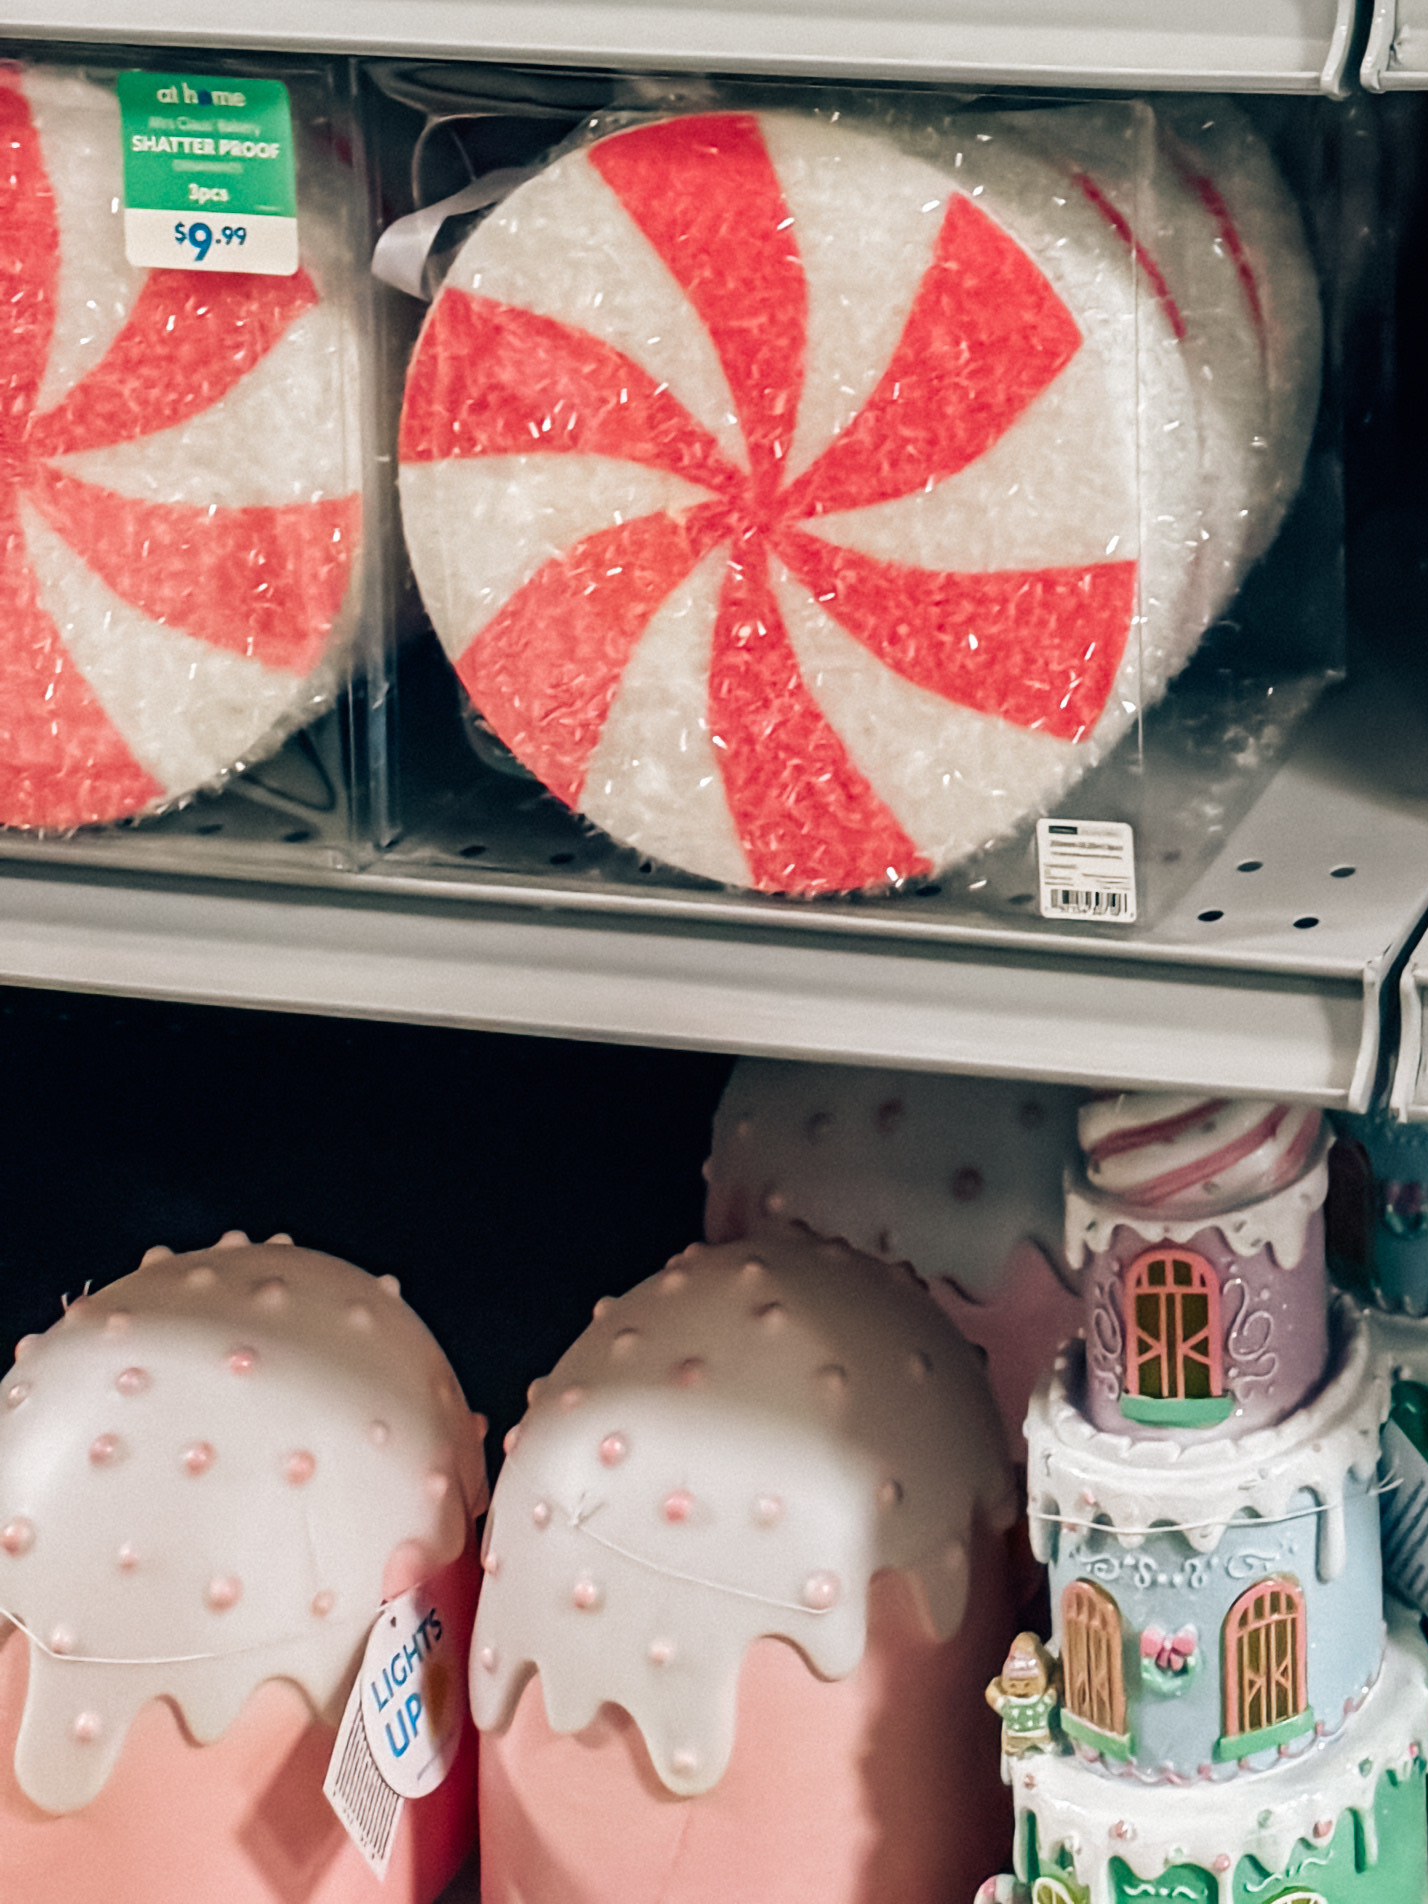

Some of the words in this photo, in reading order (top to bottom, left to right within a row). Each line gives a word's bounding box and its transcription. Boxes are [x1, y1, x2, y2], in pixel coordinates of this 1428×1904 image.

[156, 85, 179, 104] at
[132, 134, 217, 155] SHATTER
[218, 138, 281, 159] PROOF
[187, 182, 229, 205] 3pcs
[174, 220, 247, 262] $9.99
[371, 1608, 444, 1713] LIGHTS
[385, 1692, 423, 1759] UP
